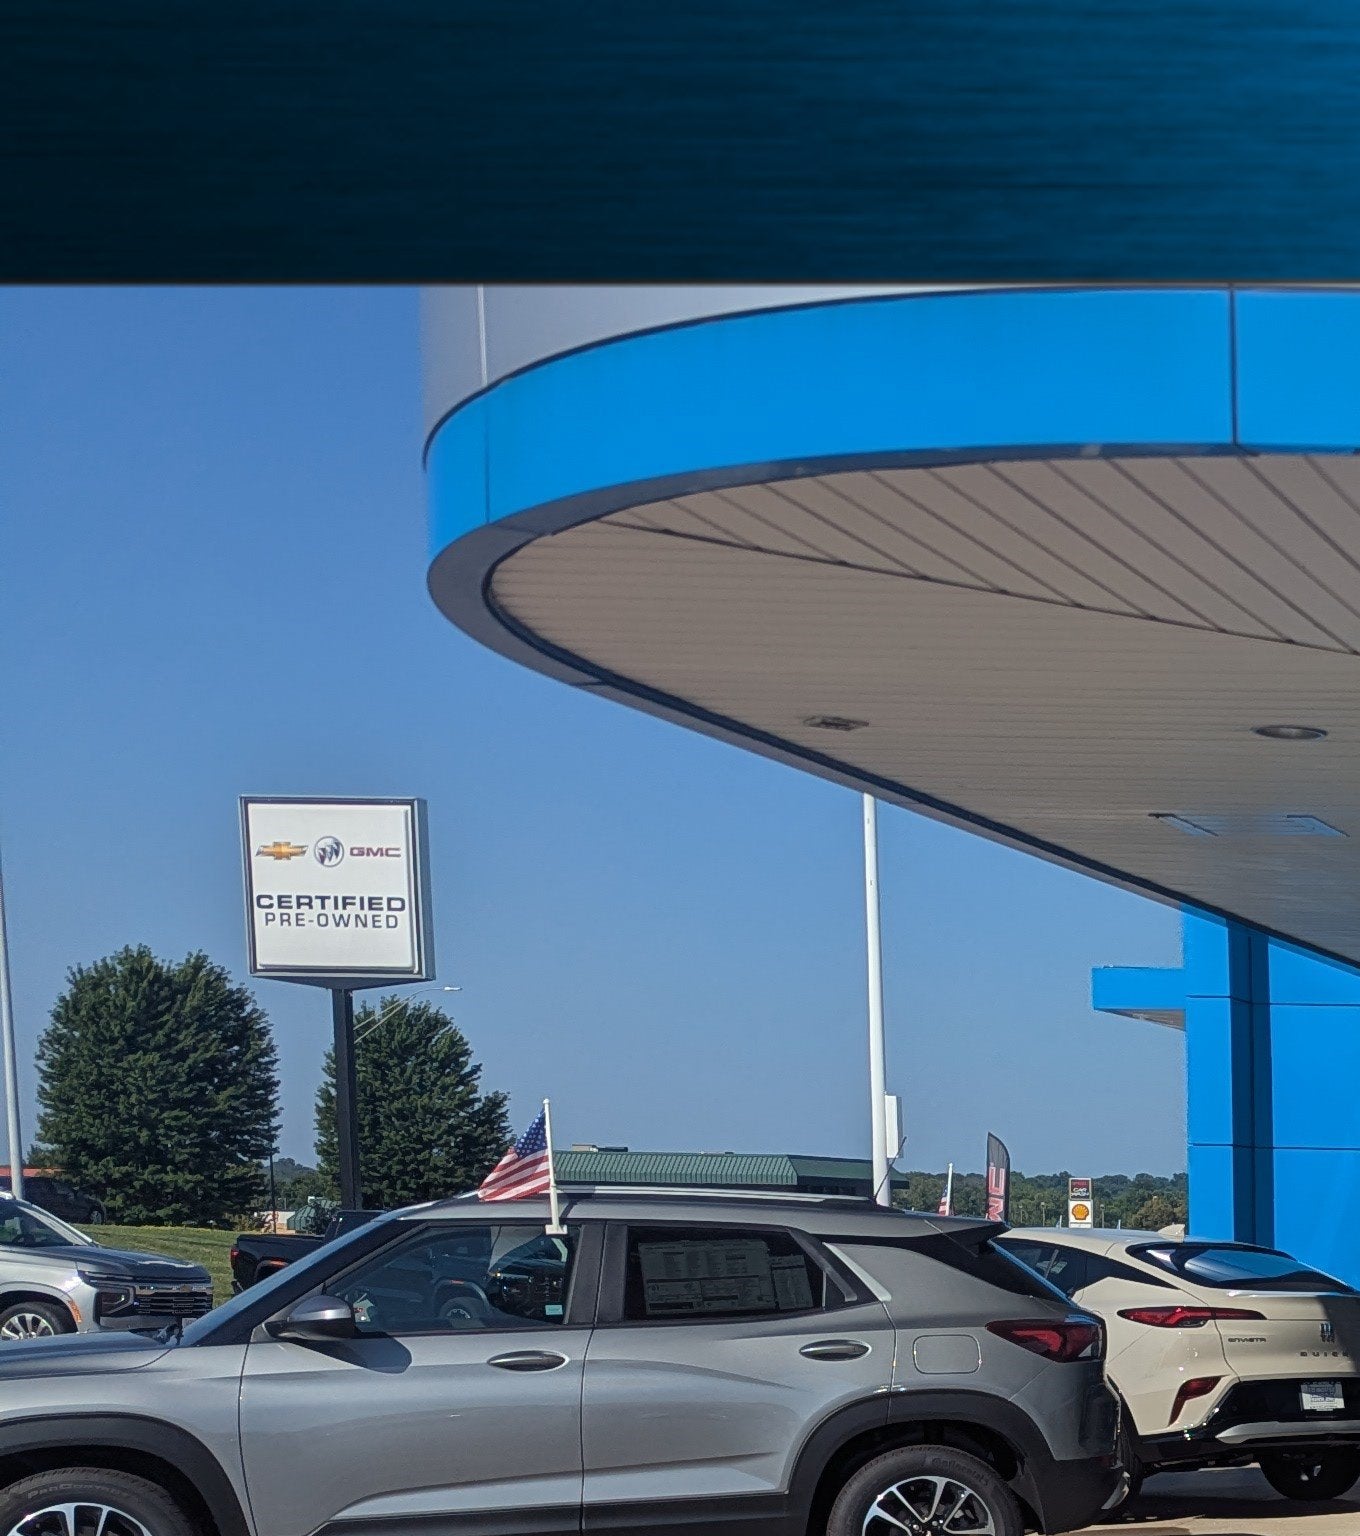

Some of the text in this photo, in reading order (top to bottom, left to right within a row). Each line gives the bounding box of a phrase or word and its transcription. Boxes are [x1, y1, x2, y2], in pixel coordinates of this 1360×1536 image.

[350, 847, 402, 858] GMC
[256, 894, 406, 912] CERTIFIED
[264, 912, 398, 929] PRE-OWNED
